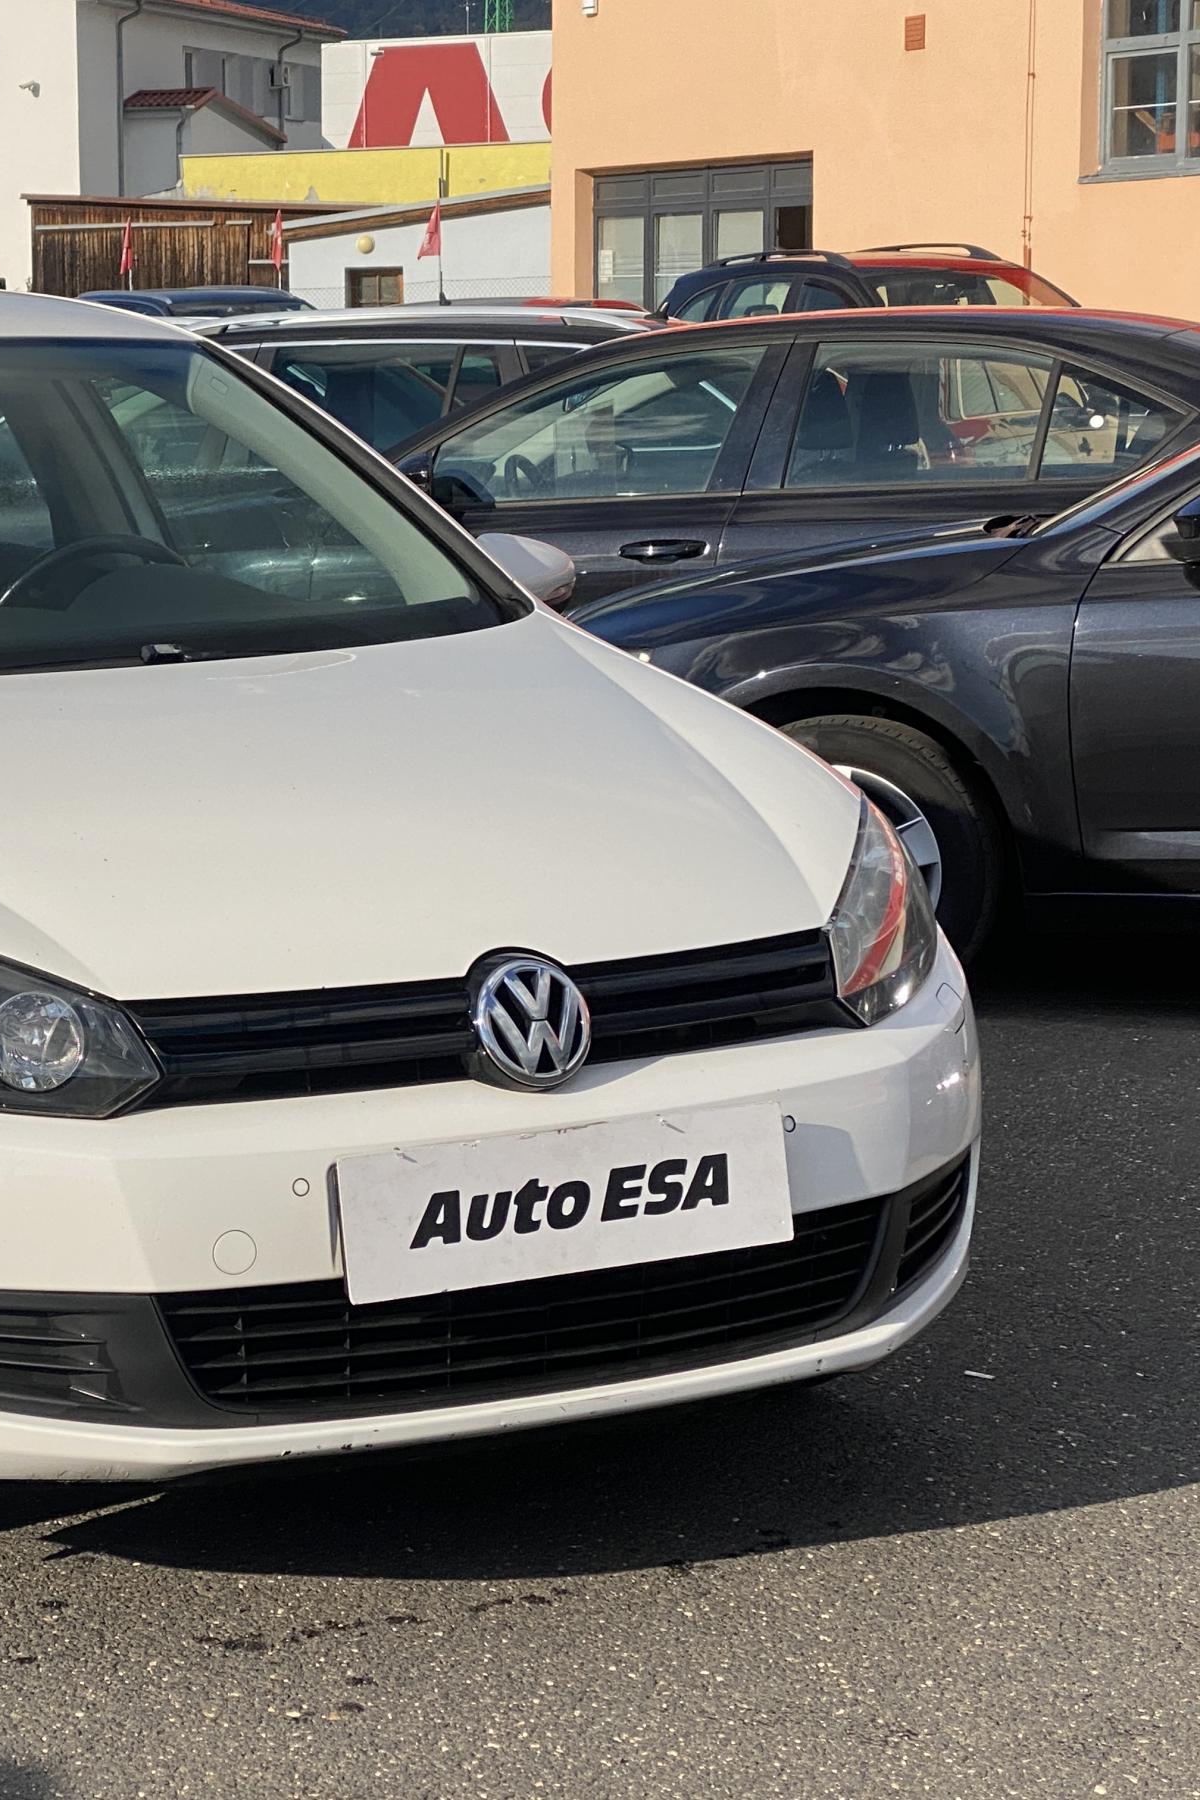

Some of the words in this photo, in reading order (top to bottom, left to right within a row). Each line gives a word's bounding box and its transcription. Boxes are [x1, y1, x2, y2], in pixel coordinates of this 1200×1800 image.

[480, 962, 588, 1083] VW
[409, 1177, 591, 1250] Auto
[600, 1153, 730, 1222] ESA
